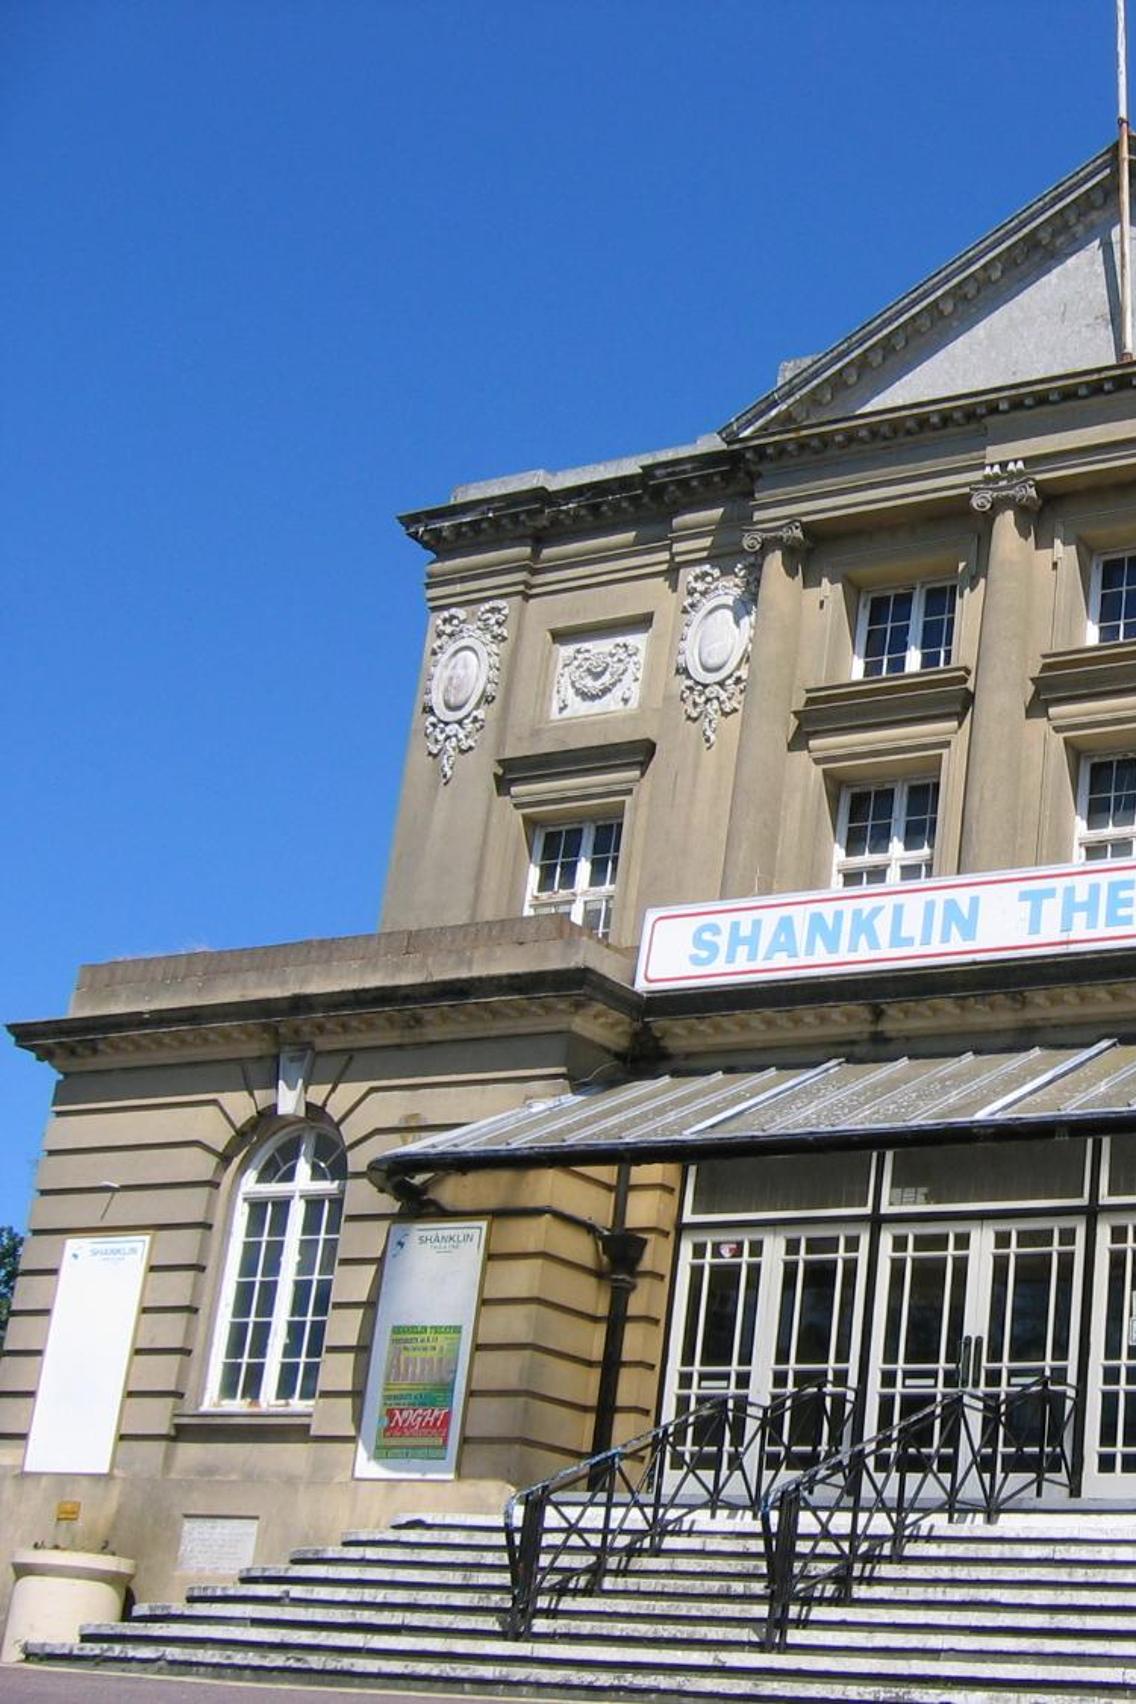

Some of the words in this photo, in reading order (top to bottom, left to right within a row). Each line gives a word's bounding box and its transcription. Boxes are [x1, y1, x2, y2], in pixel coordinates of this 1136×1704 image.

[688, 895, 980, 967] SHANKLIN
[418, 1232, 474, 1244] SHANKLIN
[390, 1408, 449, 1430] NIGHT
